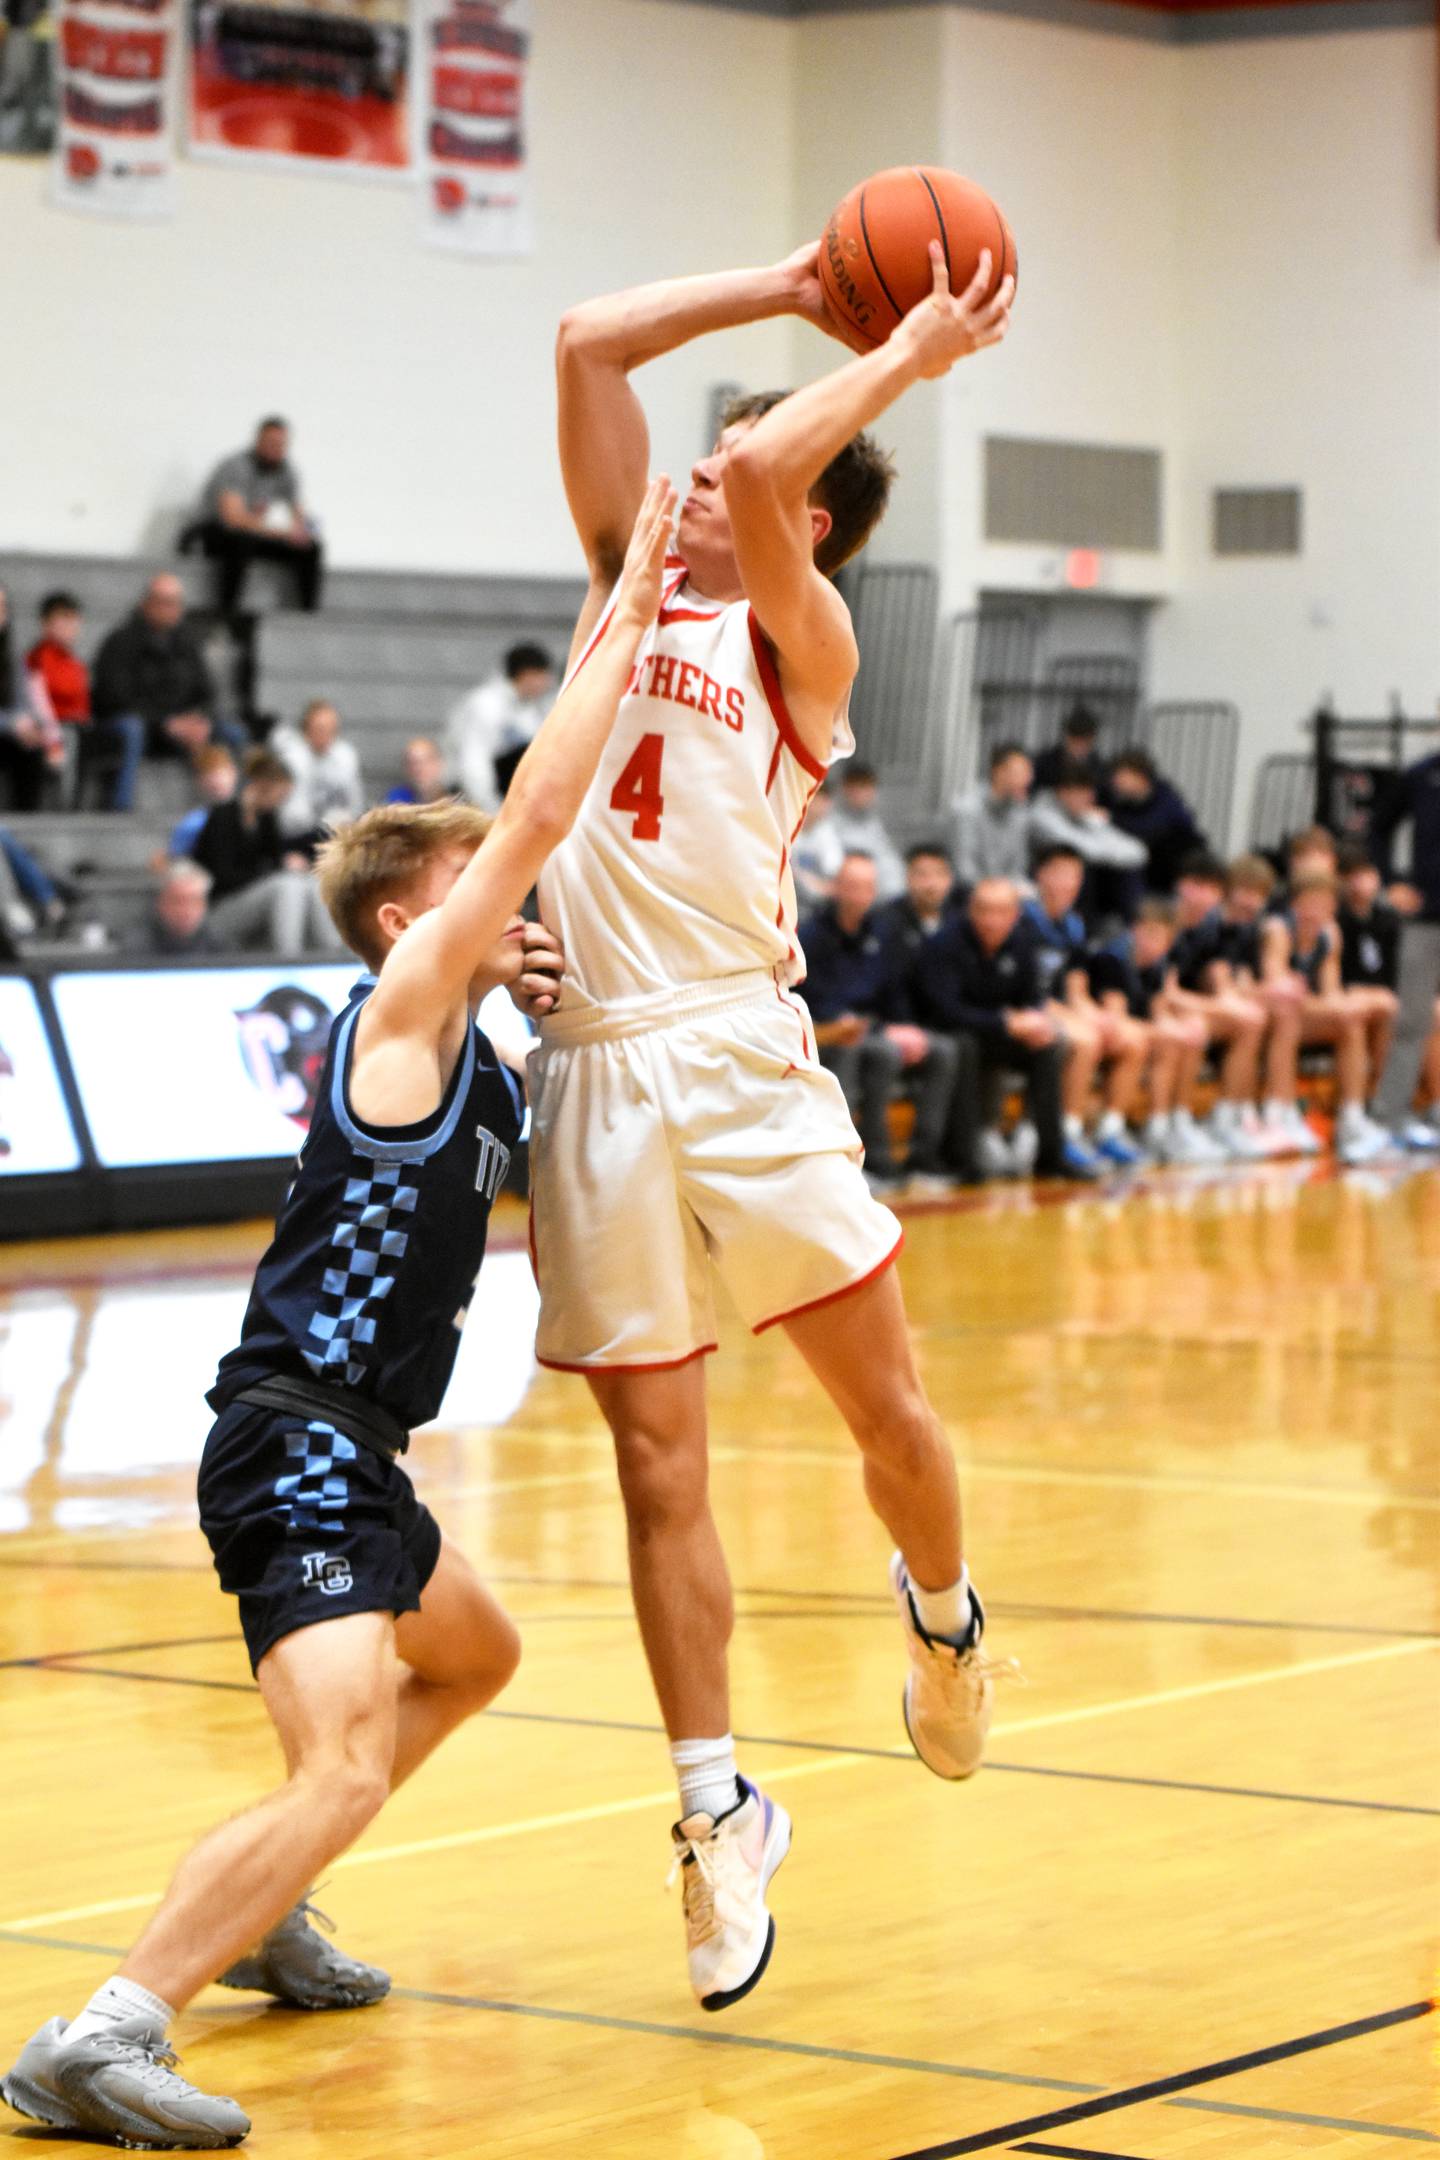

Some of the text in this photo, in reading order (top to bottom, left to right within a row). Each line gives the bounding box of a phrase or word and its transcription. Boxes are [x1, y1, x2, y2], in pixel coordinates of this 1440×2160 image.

[627, 654, 745, 733] THERS
[610, 733, 664, 842] 4
[302, 1551, 353, 1595] LC
